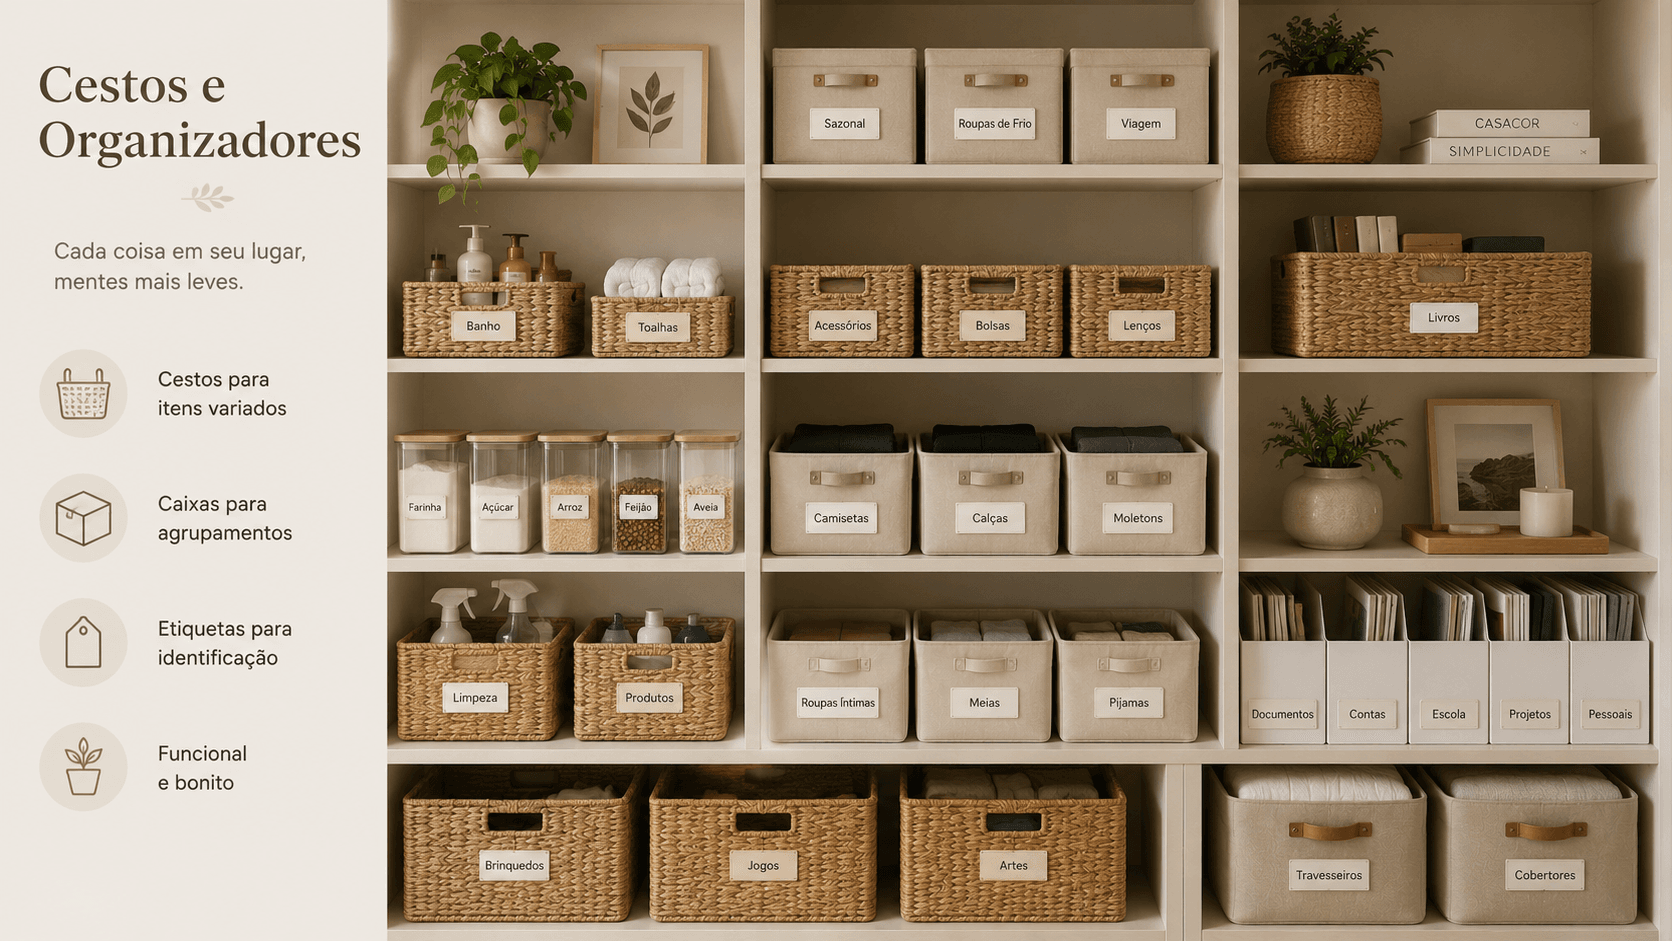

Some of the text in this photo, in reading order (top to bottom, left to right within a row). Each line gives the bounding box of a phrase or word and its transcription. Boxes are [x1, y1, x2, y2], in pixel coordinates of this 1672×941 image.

[824, 117, 866, 129] Sazonal
[958, 118, 1032, 131] Roupas de Frio
[1120, 118, 1162, 132] Viagem
[1475, 117, 1540, 130] CASACOR
[1449, 145, 1551, 157] SIMPLICIDADE
[1428, 312, 1461, 323] Livros
[466, 320, 501, 331] Banho
[637, 321, 679, 333] Toalhas
[814, 319, 872, 331] Acessórios
[975, 320, 1011, 331] Bolsas
[1123, 320, 1162, 334] Lenços
[408, 502, 442, 512] Farinha
[557, 502, 583, 512] Arroz
[693, 502, 719, 512] Aveia
[813, 512, 869, 524] Camisetas
[972, 512, 1009, 526] Calças
[1113, 512, 1164, 523] Moletons
[453, 692, 498, 706] Limpeza
[625, 692, 675, 703] Produtos
[801, 697, 838, 710] Roupas
[969, 697, 1001, 708] Meias
[1109, 696, 1150, 710] Pijamas
[1251, 708, 1315, 720] Documentos
[1349, 708, 1386, 720] Contas
[1432, 708, 1466, 720] Escola
[1509, 708, 1552, 722] Projetos
[1588, 708, 1633, 720] Pessoais
[485, 859, 545, 873] Brinquedos
[747, 860, 780, 873] Jogos
[999, 860, 1029, 871] Artes
[1295, 869, 1363, 881] Travesseiros
[1514, 869, 1576, 881] Cobertores
